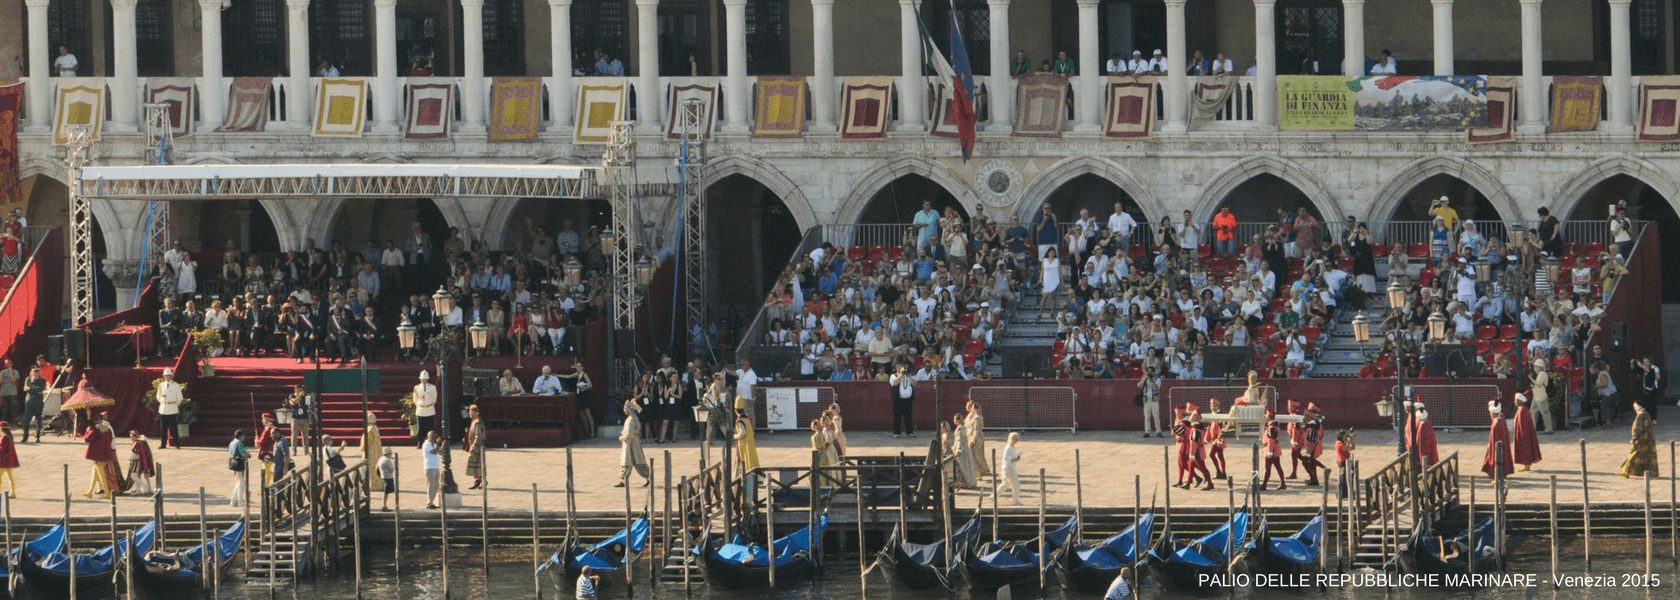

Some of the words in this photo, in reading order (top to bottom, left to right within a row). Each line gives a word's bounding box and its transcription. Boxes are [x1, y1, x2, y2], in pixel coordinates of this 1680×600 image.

[1286, 93, 1298, 101] LA
[1301, 93, 1347, 101] GUARDIA
[1286, 102, 1298, 110] DI
[1302, 102, 1347, 110] FINANZA
